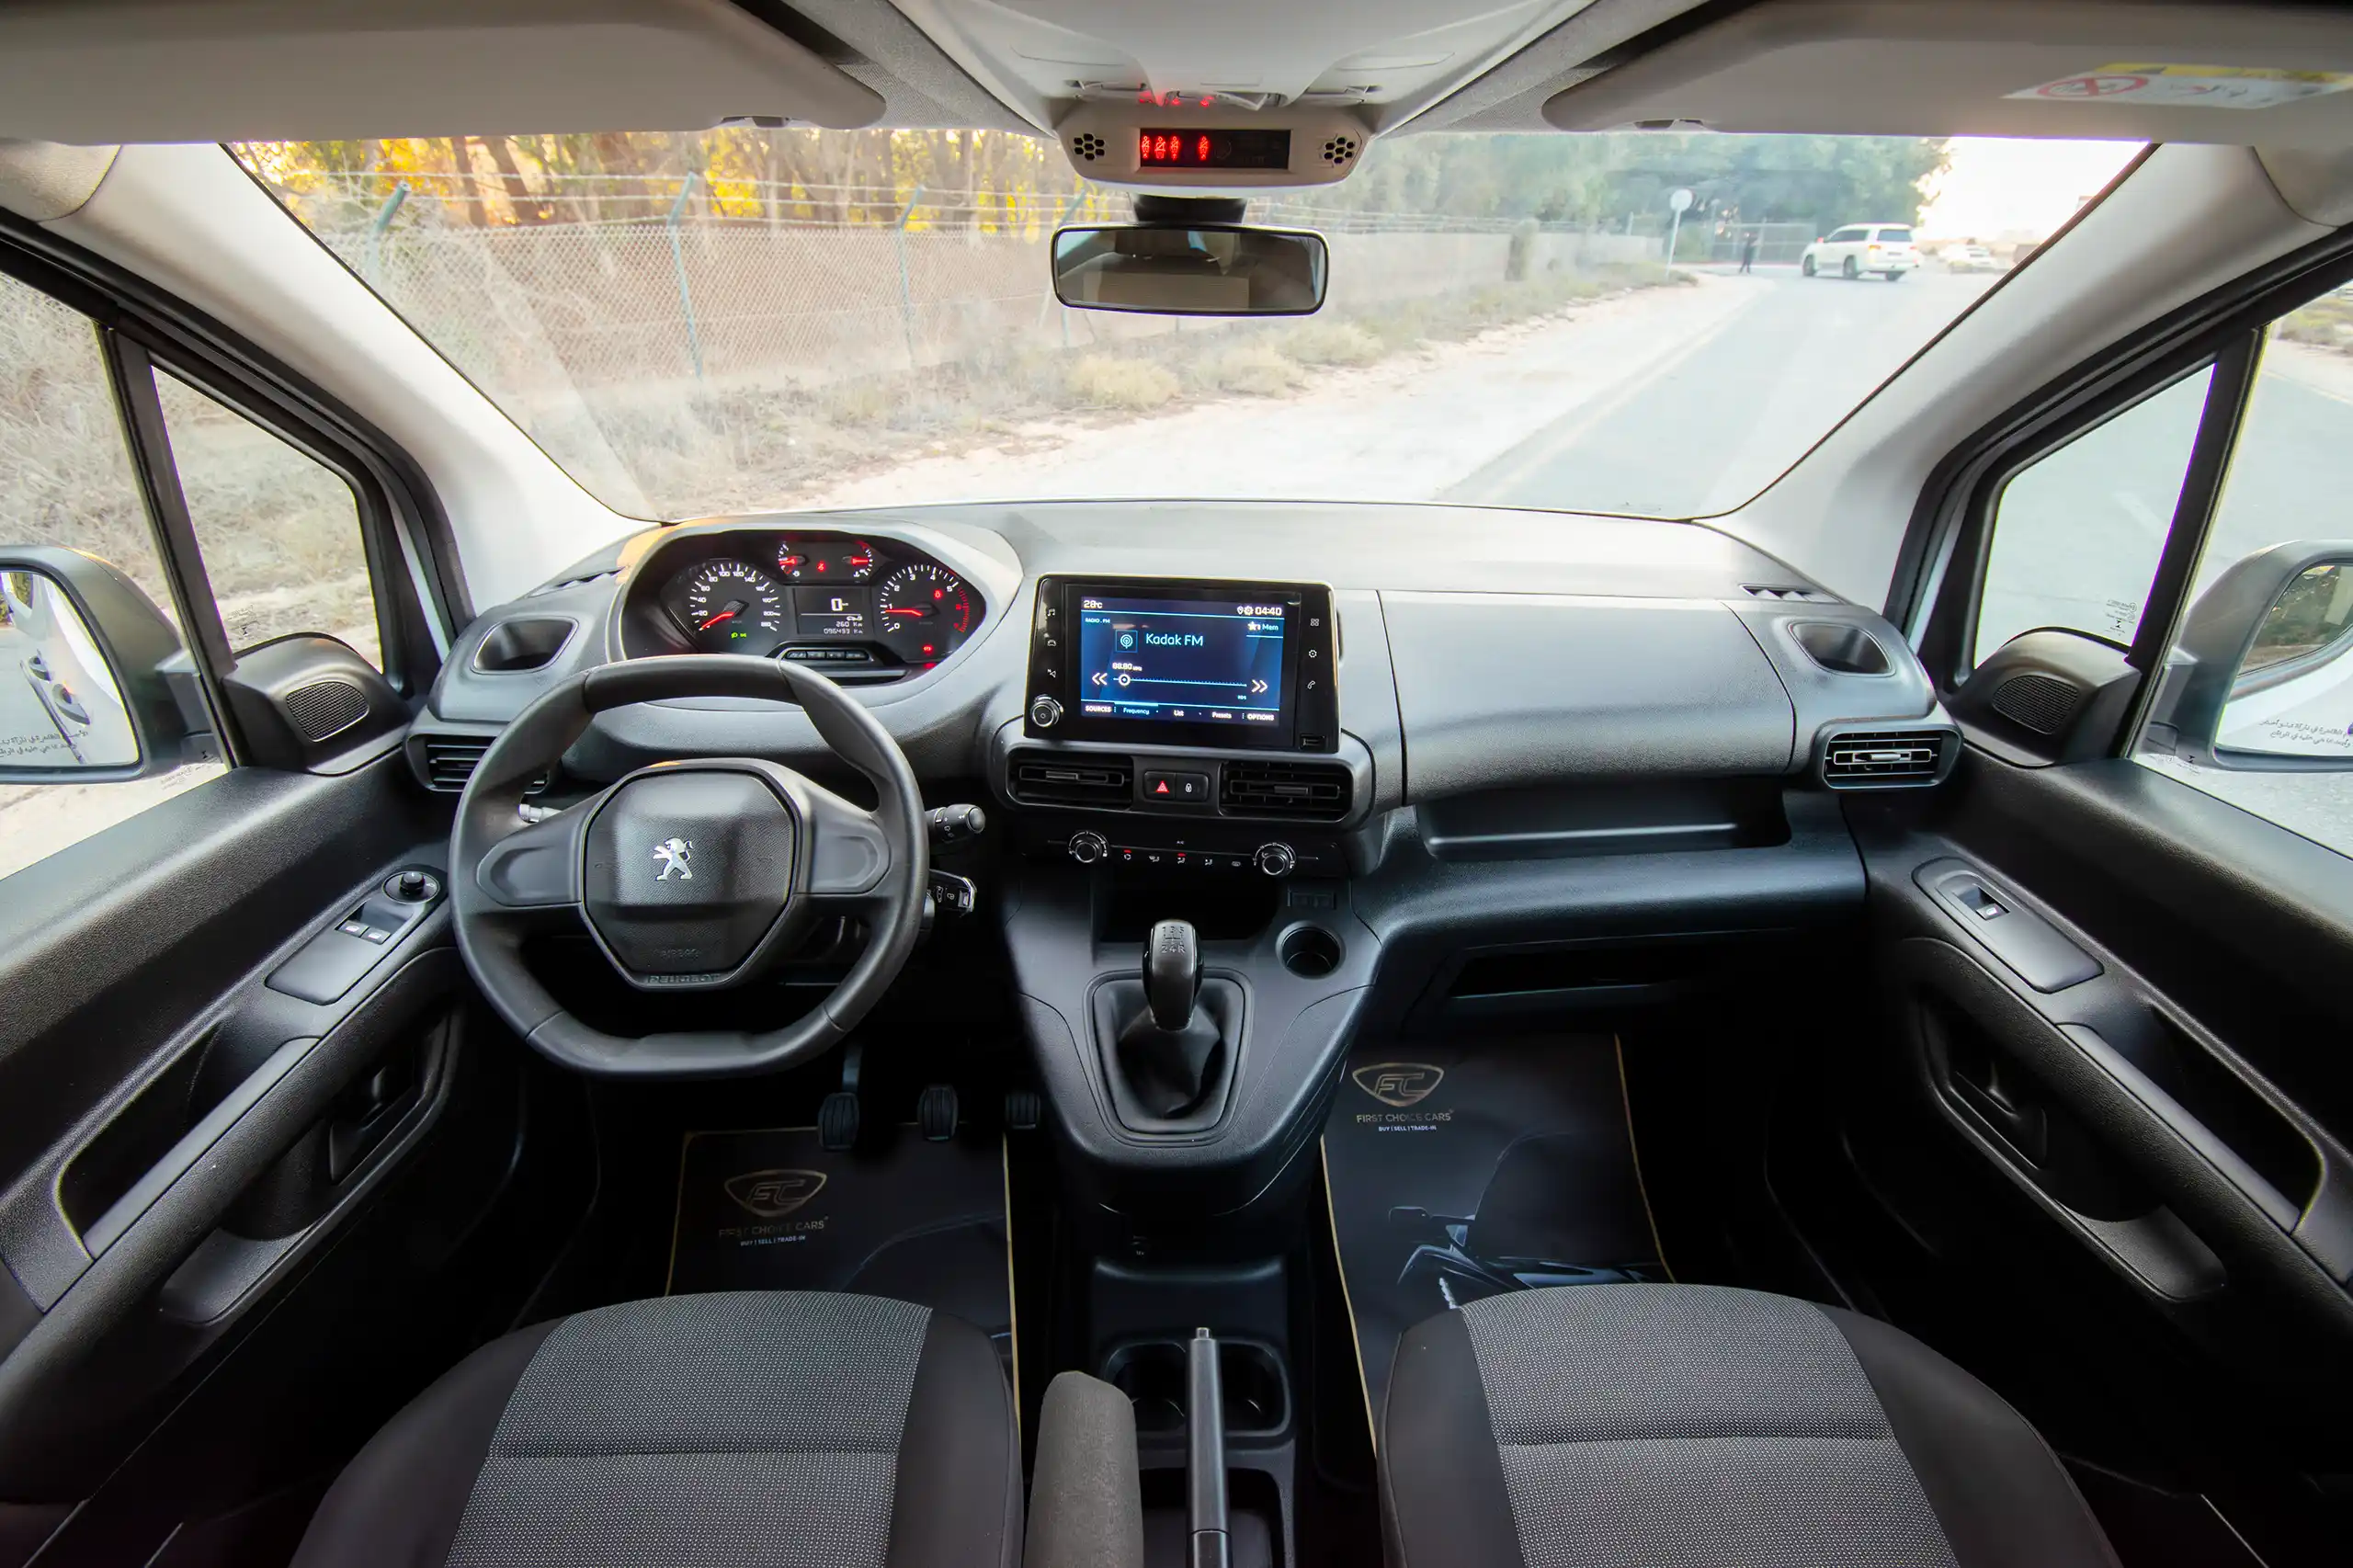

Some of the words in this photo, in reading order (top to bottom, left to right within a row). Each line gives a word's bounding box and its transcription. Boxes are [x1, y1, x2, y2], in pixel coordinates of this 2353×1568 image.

[1255, 607, 1282, 616] 04:40
[1145, 633, 1182, 645] Kadak
[1184, 634, 1203, 646] FM
[1123, 707, 1150, 715] Frequency
[1161, 944, 1167, 953] 2
[1169, 944, 1176, 953] 4
[1177, 944, 1186, 953] R
[647, 974, 721, 983] PEUGEOT
[1356, 1114, 1382, 1123] FIRST
[1385, 1113, 1422, 1122] CHOICE
[1425, 1112, 1451, 1121] CARS
[795, 1220, 824, 1231] CARS
